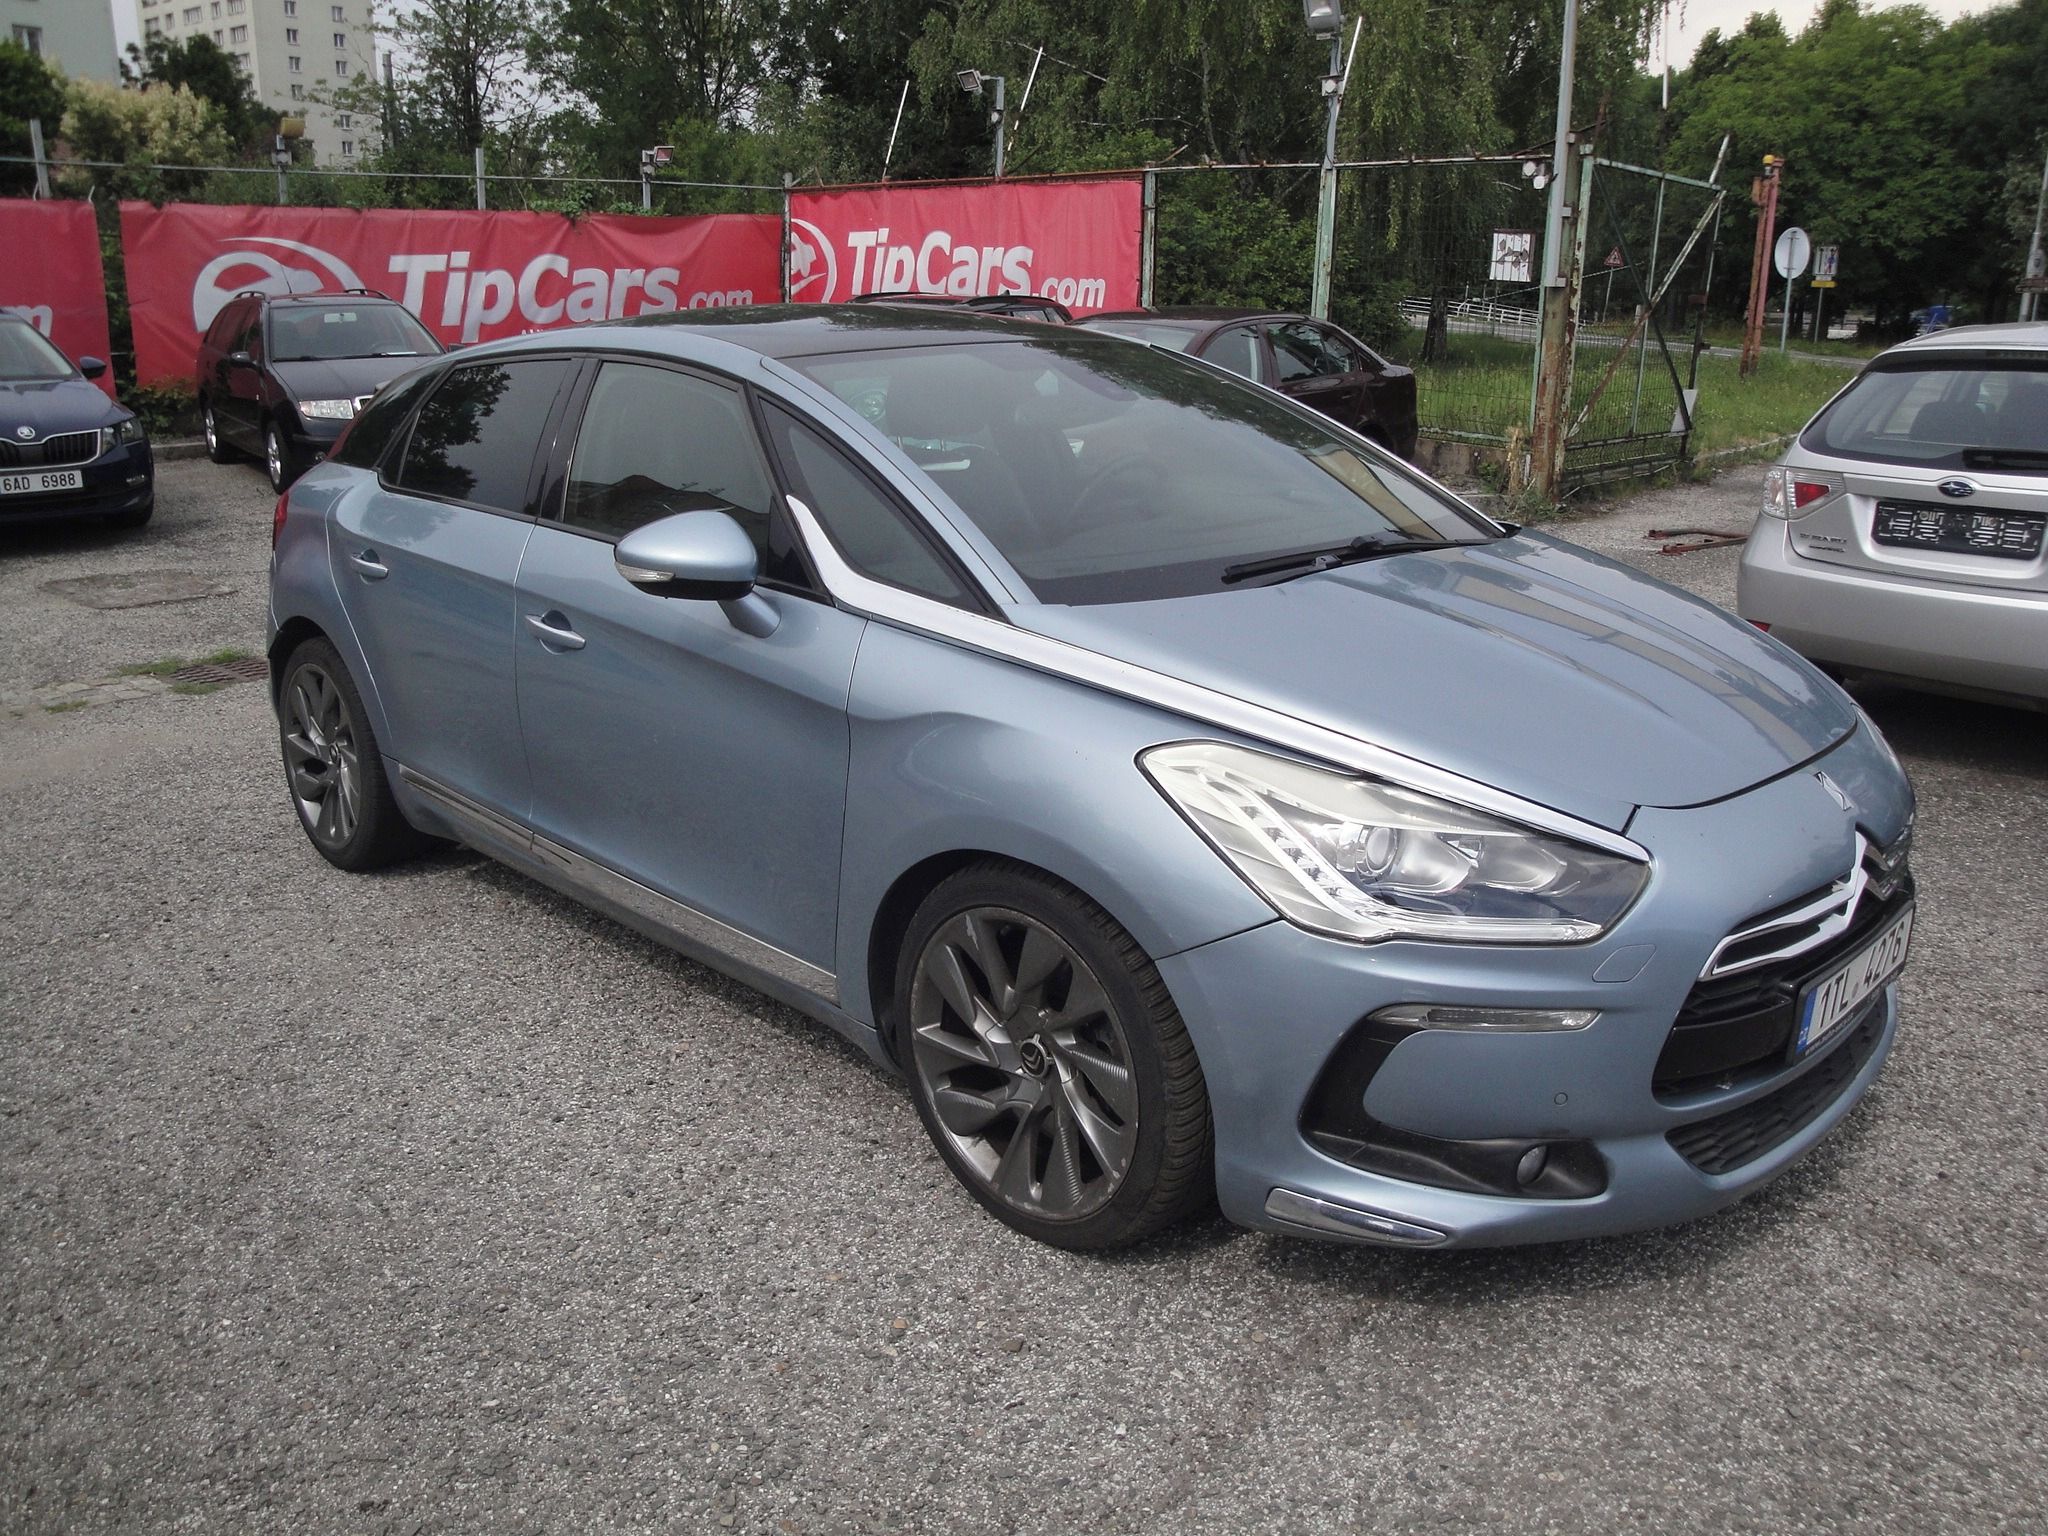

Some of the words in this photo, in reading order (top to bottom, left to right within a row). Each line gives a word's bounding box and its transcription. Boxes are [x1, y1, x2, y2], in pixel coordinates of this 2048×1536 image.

[3, 477, 31, 492] 6AD
[41, 473, 76, 488] 6988
[1820, 967, 1850, 1028] 1TL
[1863, 921, 1905, 988] 4276
